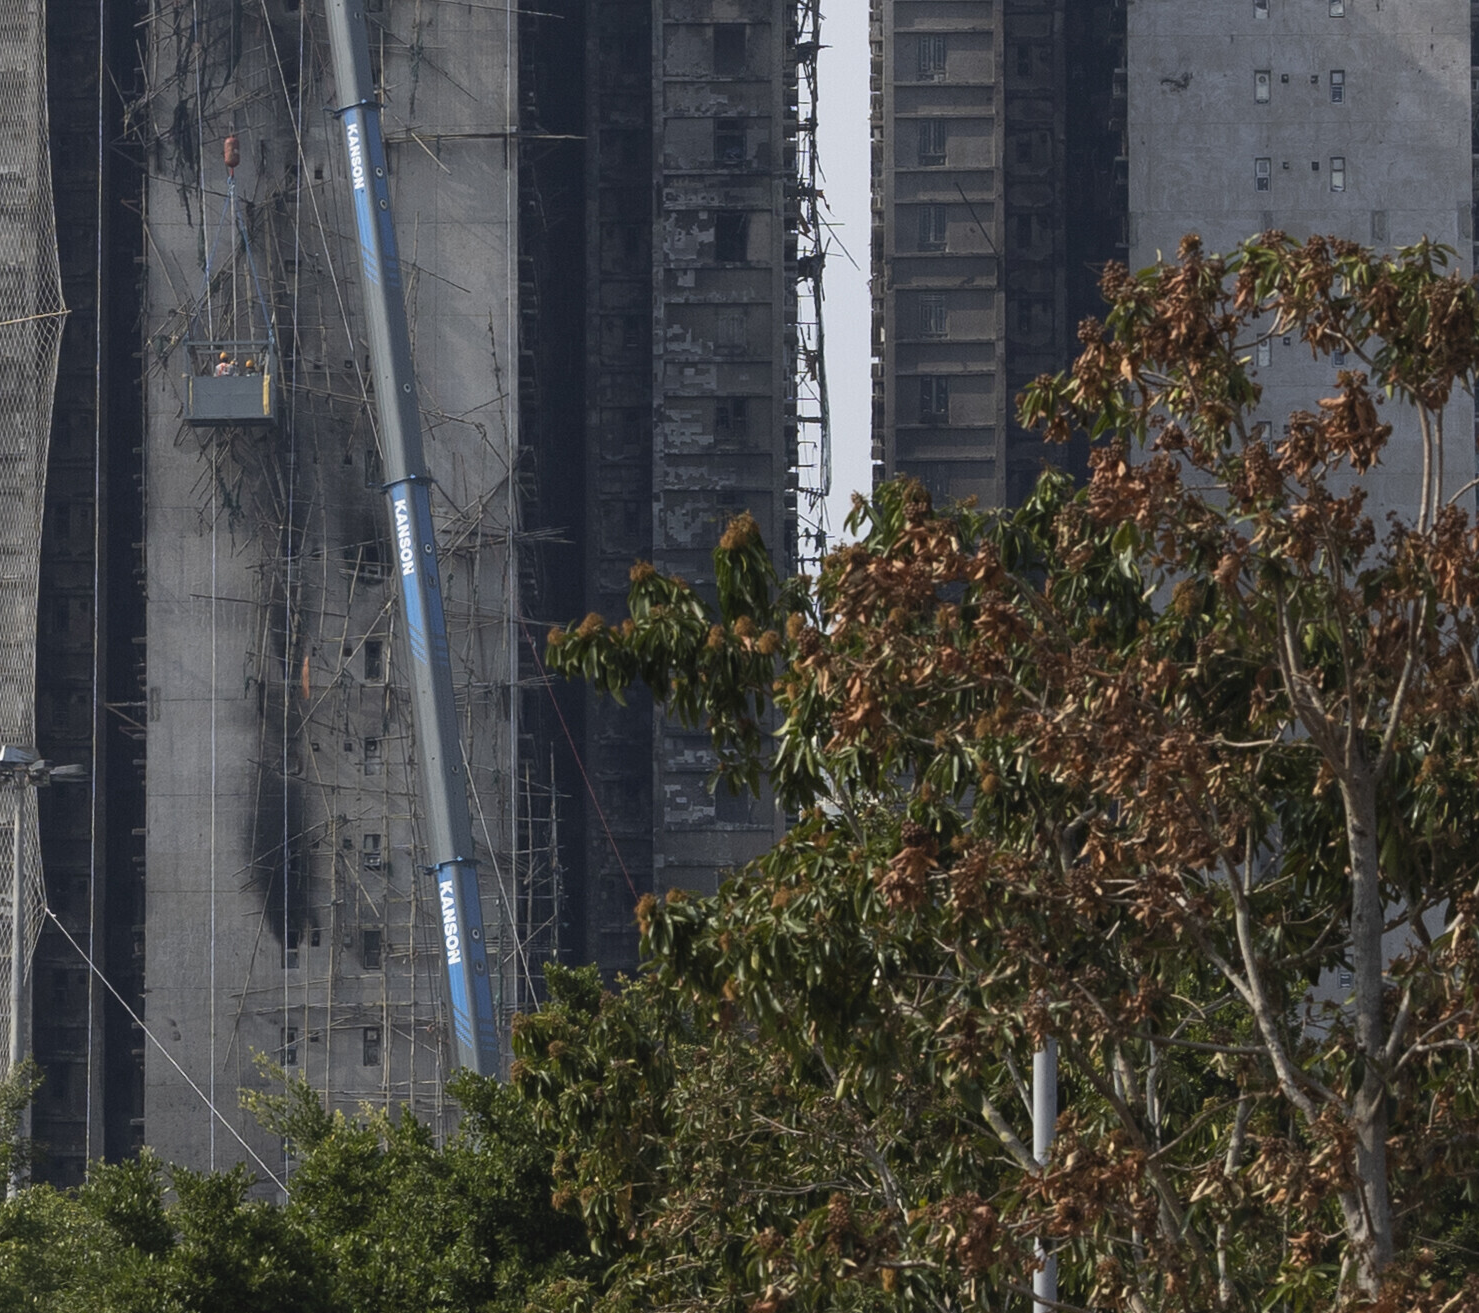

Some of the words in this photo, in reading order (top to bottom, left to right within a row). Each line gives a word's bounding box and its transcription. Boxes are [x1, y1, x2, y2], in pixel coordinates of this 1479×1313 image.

[346, 123, 365, 190] KANSON
[394, 499, 415, 576] KANSON
[439, 880, 461, 966] KANSON
